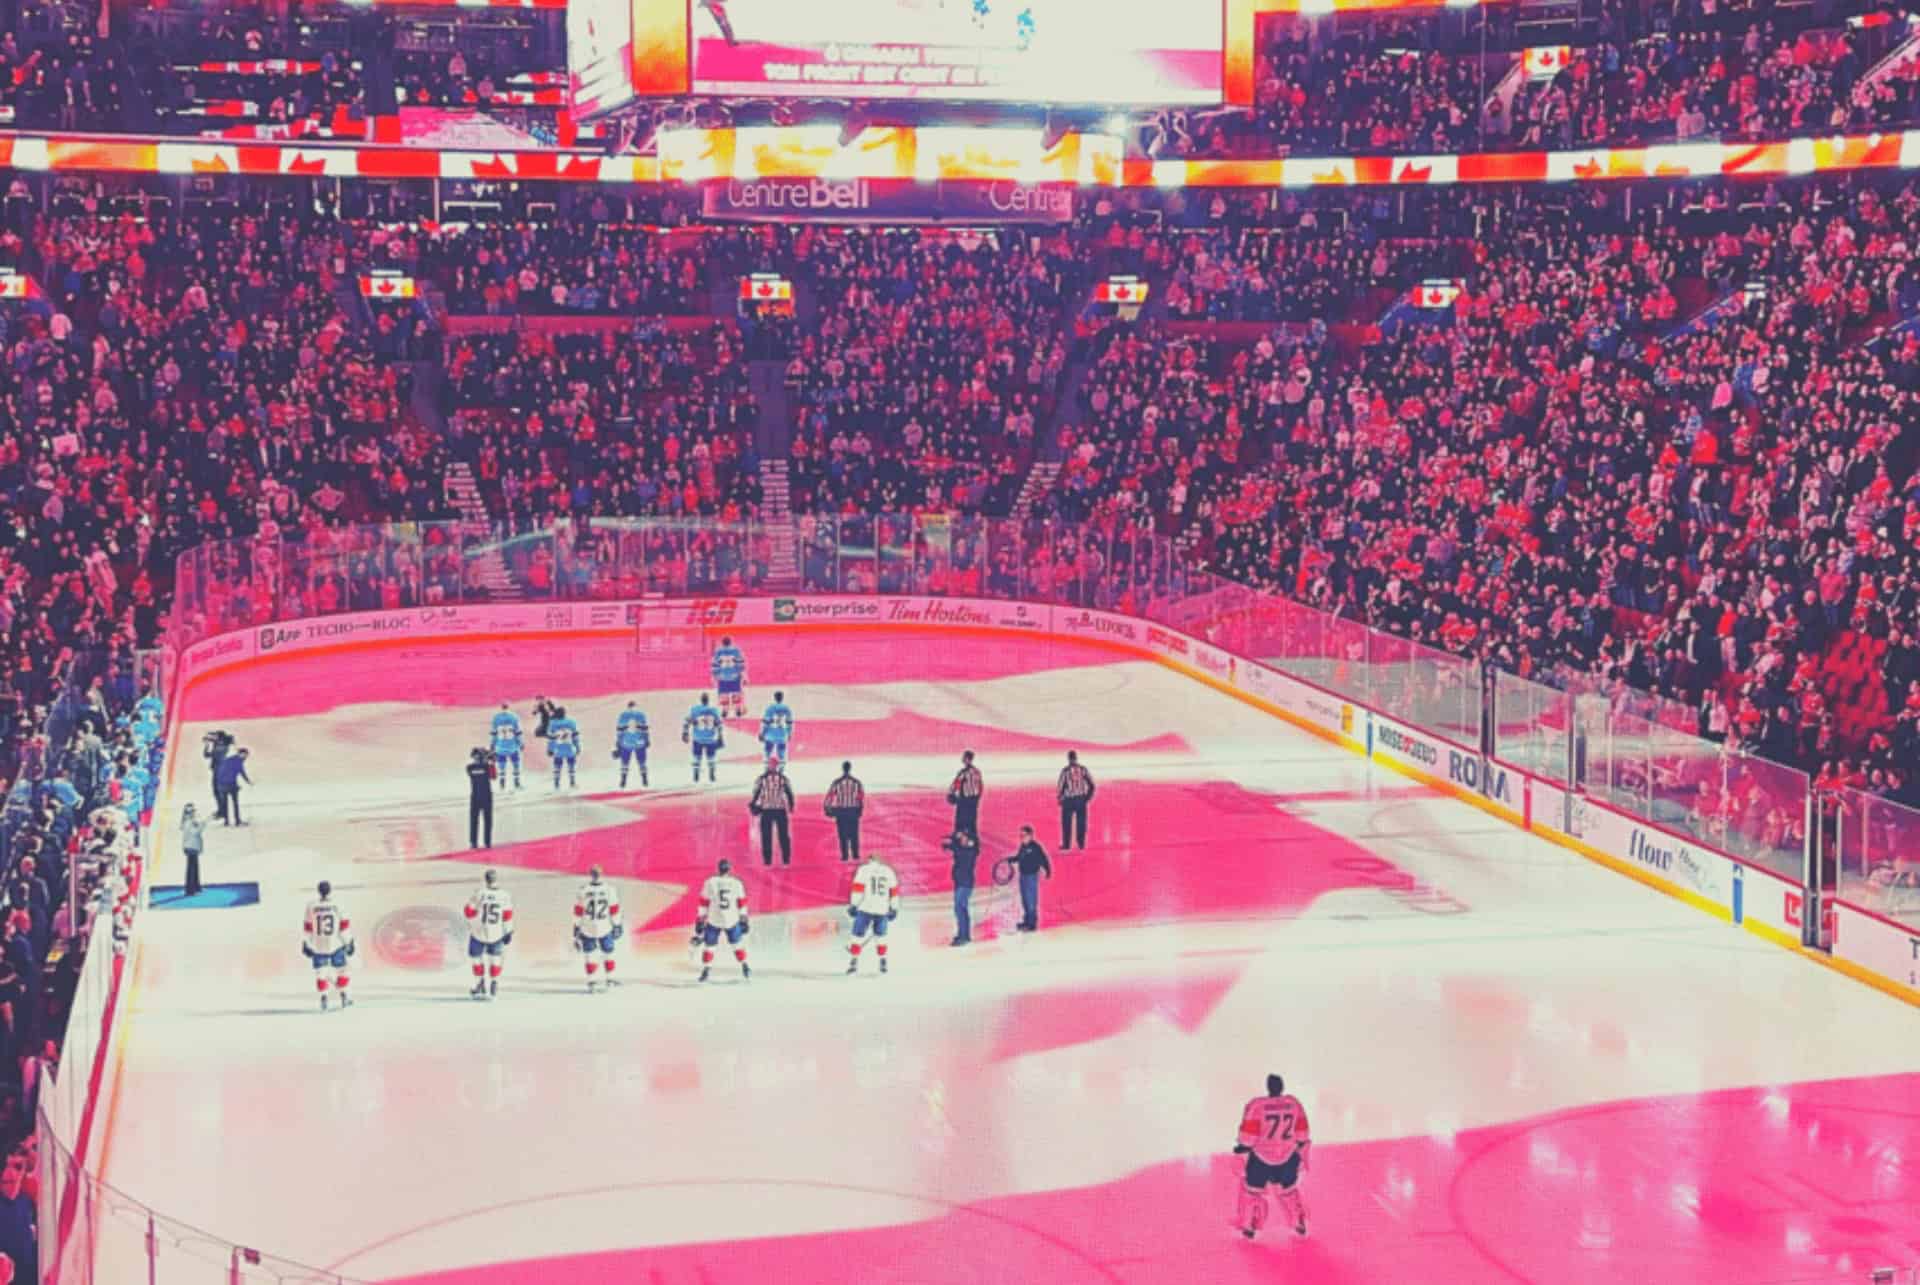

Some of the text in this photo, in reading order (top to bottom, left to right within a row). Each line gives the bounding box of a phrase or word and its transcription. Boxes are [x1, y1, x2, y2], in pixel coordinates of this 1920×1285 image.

[888, 600, 992, 624] Tim Hortons
[585, 899, 608, 920] 42
[719, 889, 730, 910] 5
[481, 903, 500, 924] 15
[316, 914, 335, 936] 13
[1265, 1113, 1294, 1140] 72
